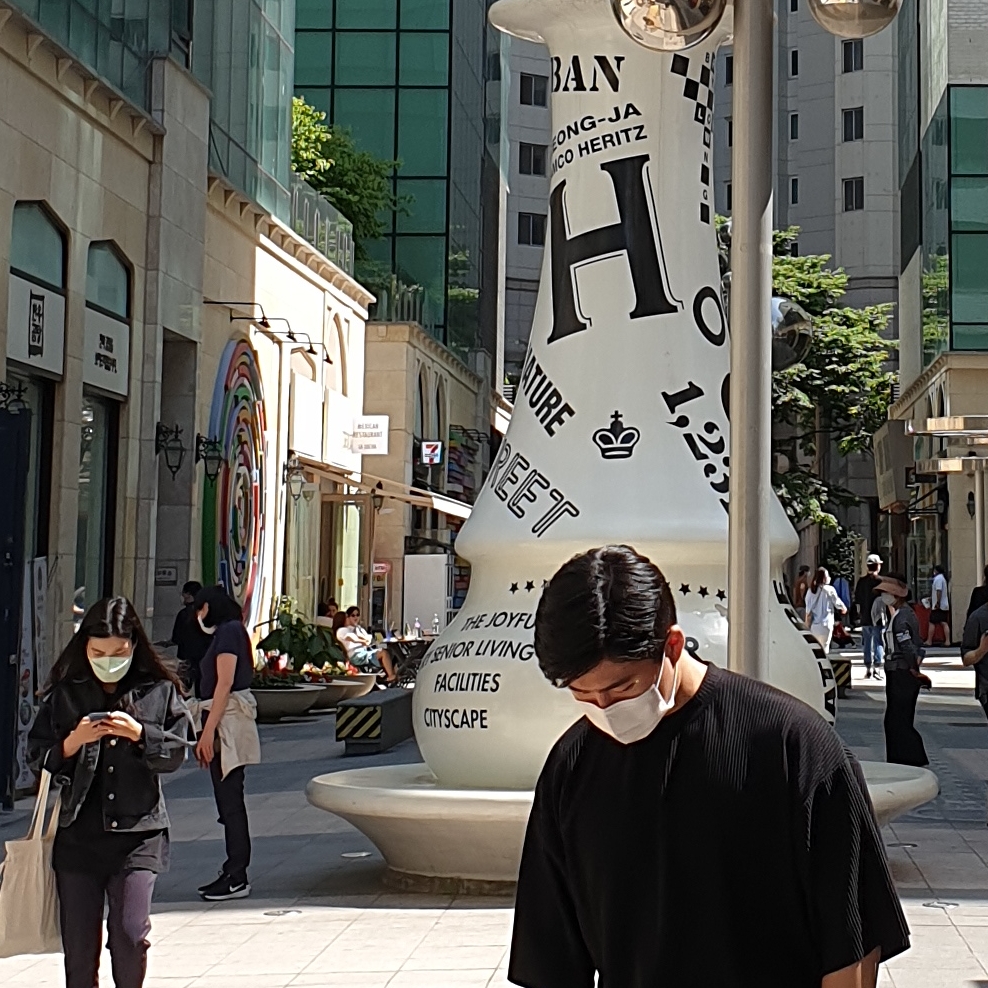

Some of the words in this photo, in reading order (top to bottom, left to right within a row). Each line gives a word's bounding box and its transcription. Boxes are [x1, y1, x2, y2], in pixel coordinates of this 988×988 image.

[577, 124, 649, 159] HERITZ
[523, 344, 576, 438] ATURE
[461, 613, 488, 631] THE
[430, 640, 475, 663] SENIOR
[475, 640, 535, 661] LIVING
[434, 672, 502, 692] FACILITIES
[424, 707, 488, 729] CITYSCAPE
